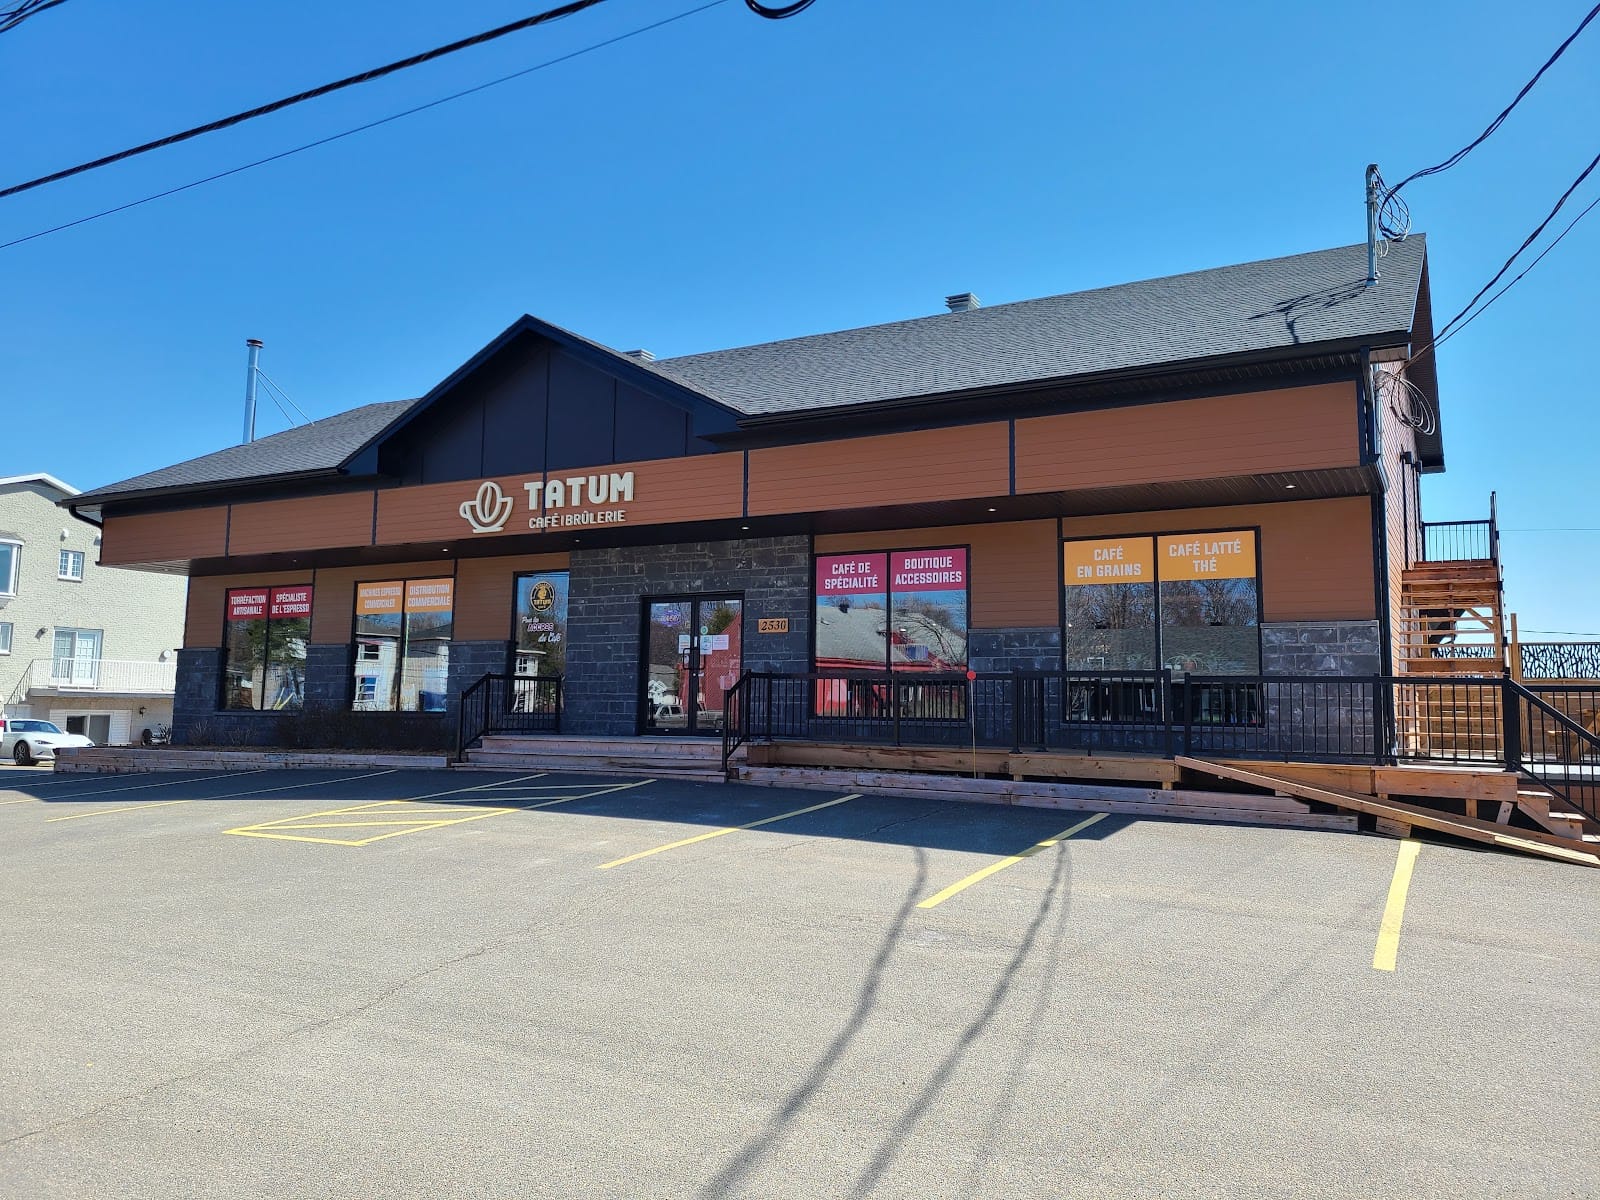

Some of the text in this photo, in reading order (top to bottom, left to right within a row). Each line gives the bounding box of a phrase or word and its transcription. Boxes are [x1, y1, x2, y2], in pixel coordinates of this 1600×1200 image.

[523, 471, 635, 510] TATUM
[528, 509, 627, 529] CAFÉ BRÛLERIE
[1094, 545, 1124, 561] CAFÉ
[1169, 538, 1241, 557] CAFÉ LATTÉ
[832, 561, 871, 575] CAFÉ DE
[904, 556, 953, 570] BOUTIQUE
[1193, 557, 1217, 573] THÉ
[1076, 563, 1142, 578] EN GRAINS
[824, 574, 879, 590] SPÉCIALITÉ
[895, 571, 962, 585] ACCESSOIRES
[409, 584, 450, 595] DISTRIBUTION
[231, 594, 267, 605] TORRÉFACTION
[276, 592, 307, 603] SPÉCIALISTE
[407, 596, 451, 607] COMMERCIALE
[233, 605, 263, 616] ARTISANALE
[272, 603, 310, 614] DE L'ESPRESSO
[760, 620, 787, 631] 2530
